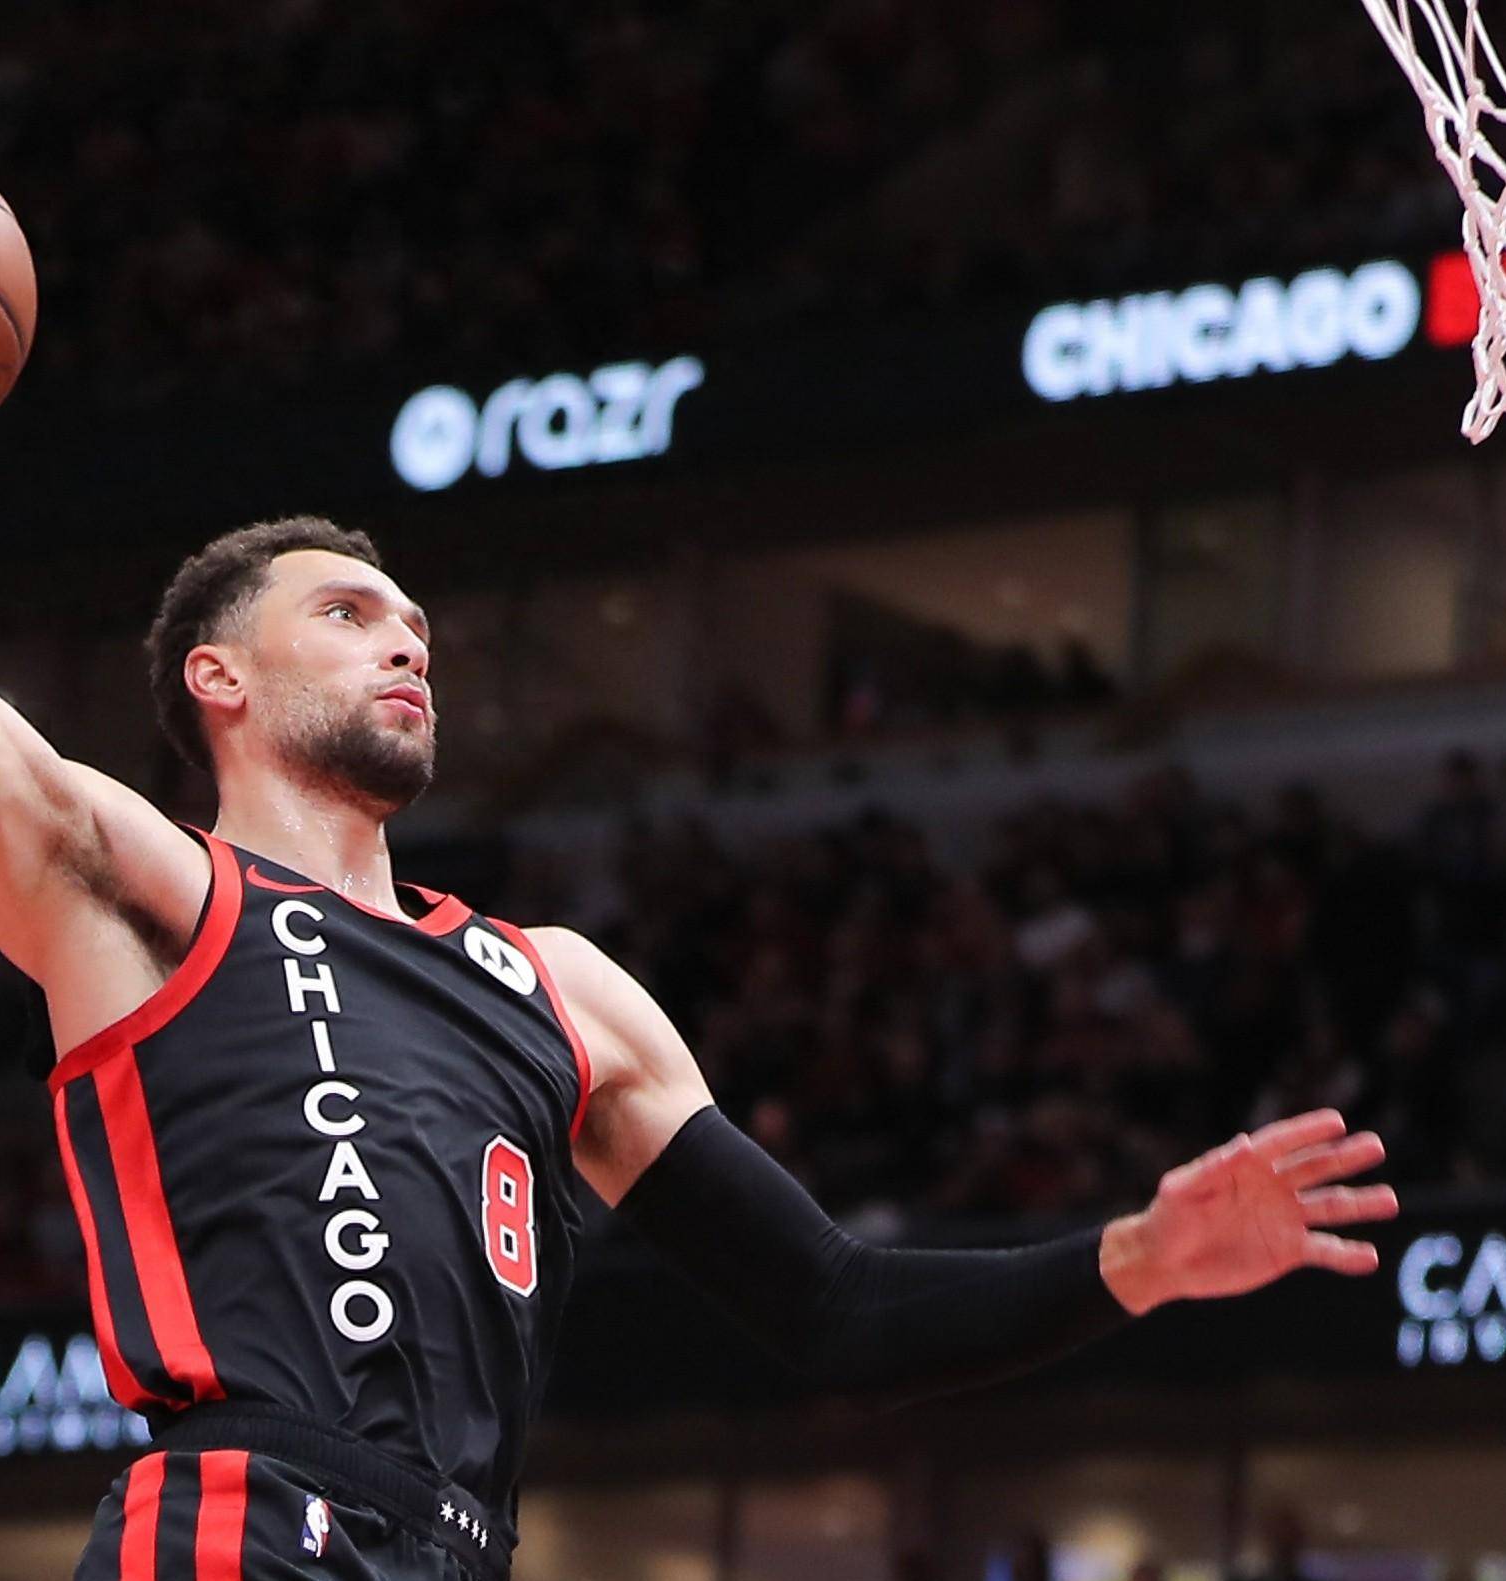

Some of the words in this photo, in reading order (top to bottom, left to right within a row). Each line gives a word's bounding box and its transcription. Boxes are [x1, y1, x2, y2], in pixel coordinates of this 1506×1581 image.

[1022, 258, 1421, 402] CHICAGO
[475, 356, 706, 479] razr
[271, 899, 393, 1342] CHICAGO
[481, 1134, 538, 1298] 8
